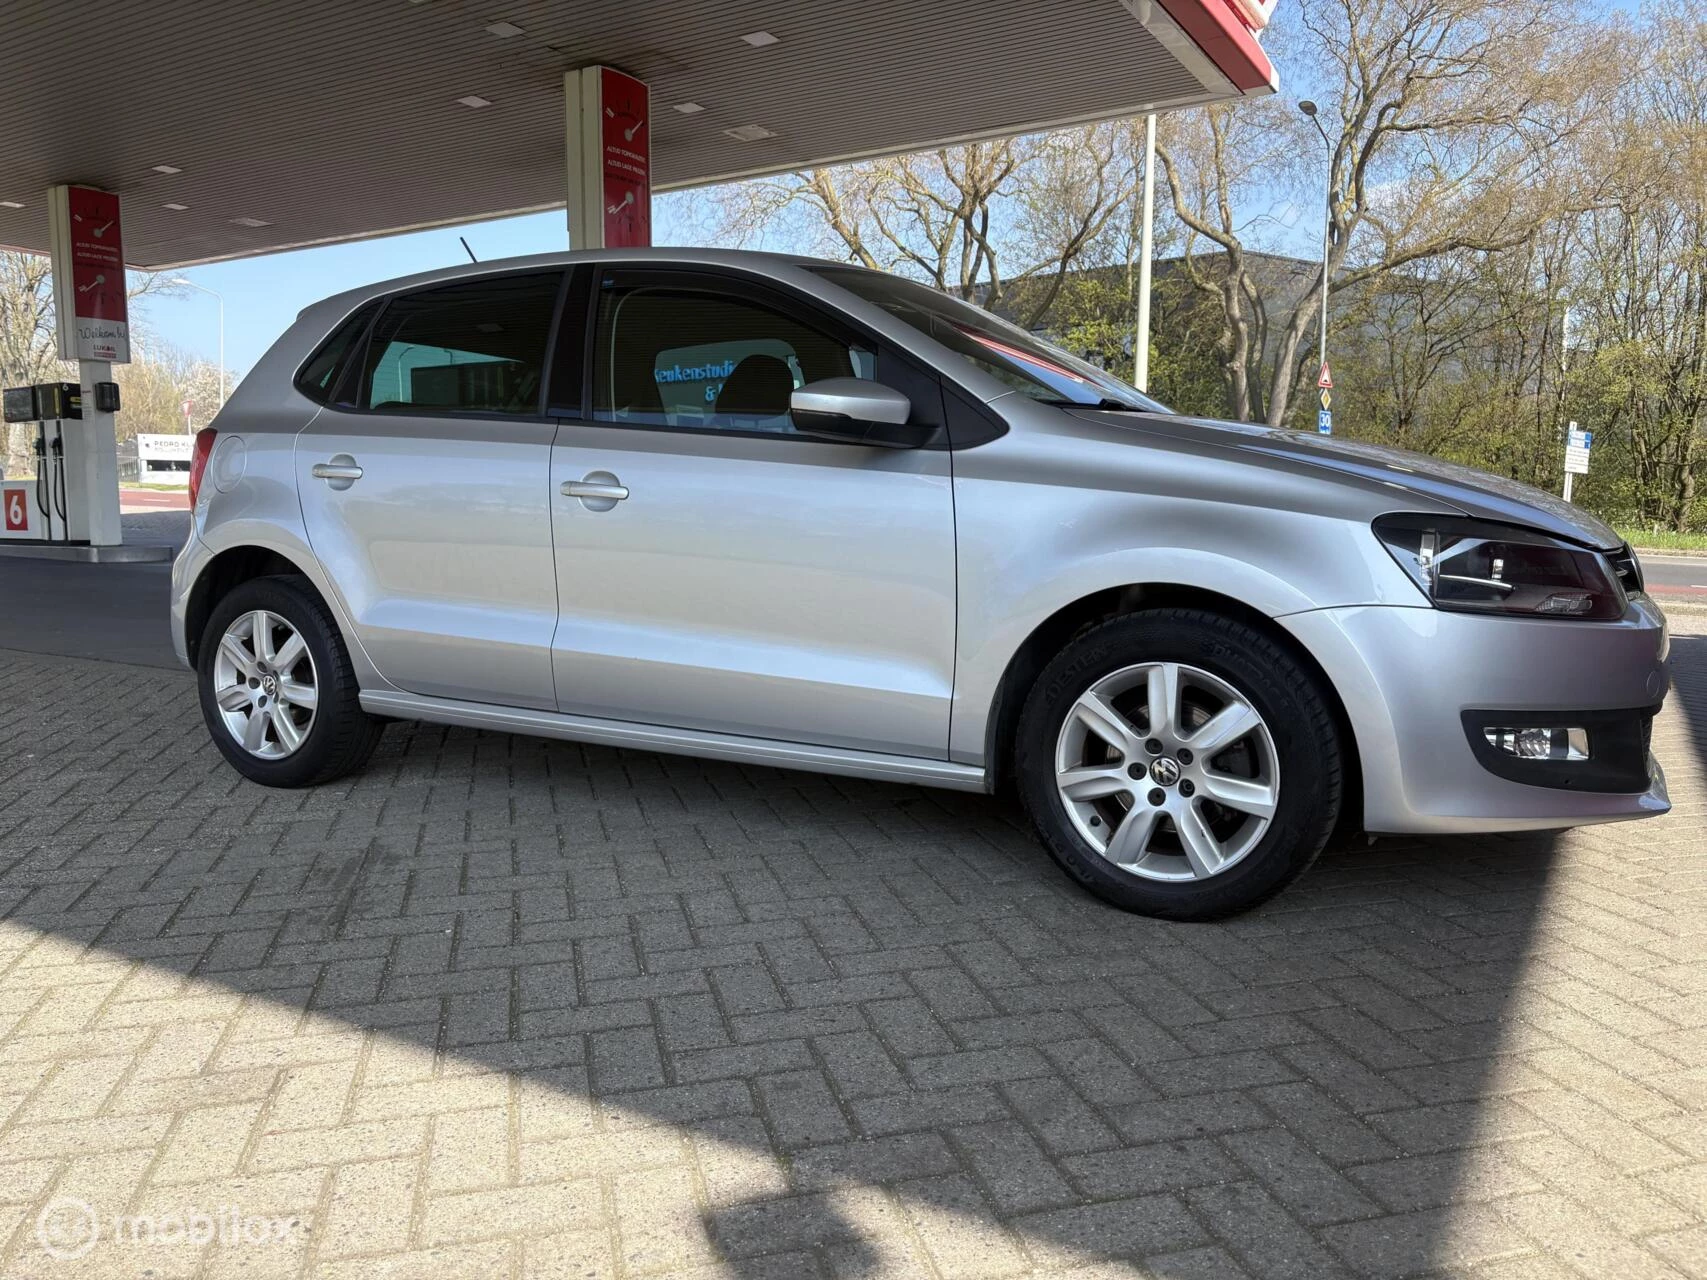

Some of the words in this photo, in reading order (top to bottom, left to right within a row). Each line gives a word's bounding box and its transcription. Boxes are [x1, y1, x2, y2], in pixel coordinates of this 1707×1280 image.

[705, 386, 717, 402] &
[1320, 414, 1330, 427] 30
[154, 440, 180, 448] PEDRO
[10, 496, 22, 525] 6
